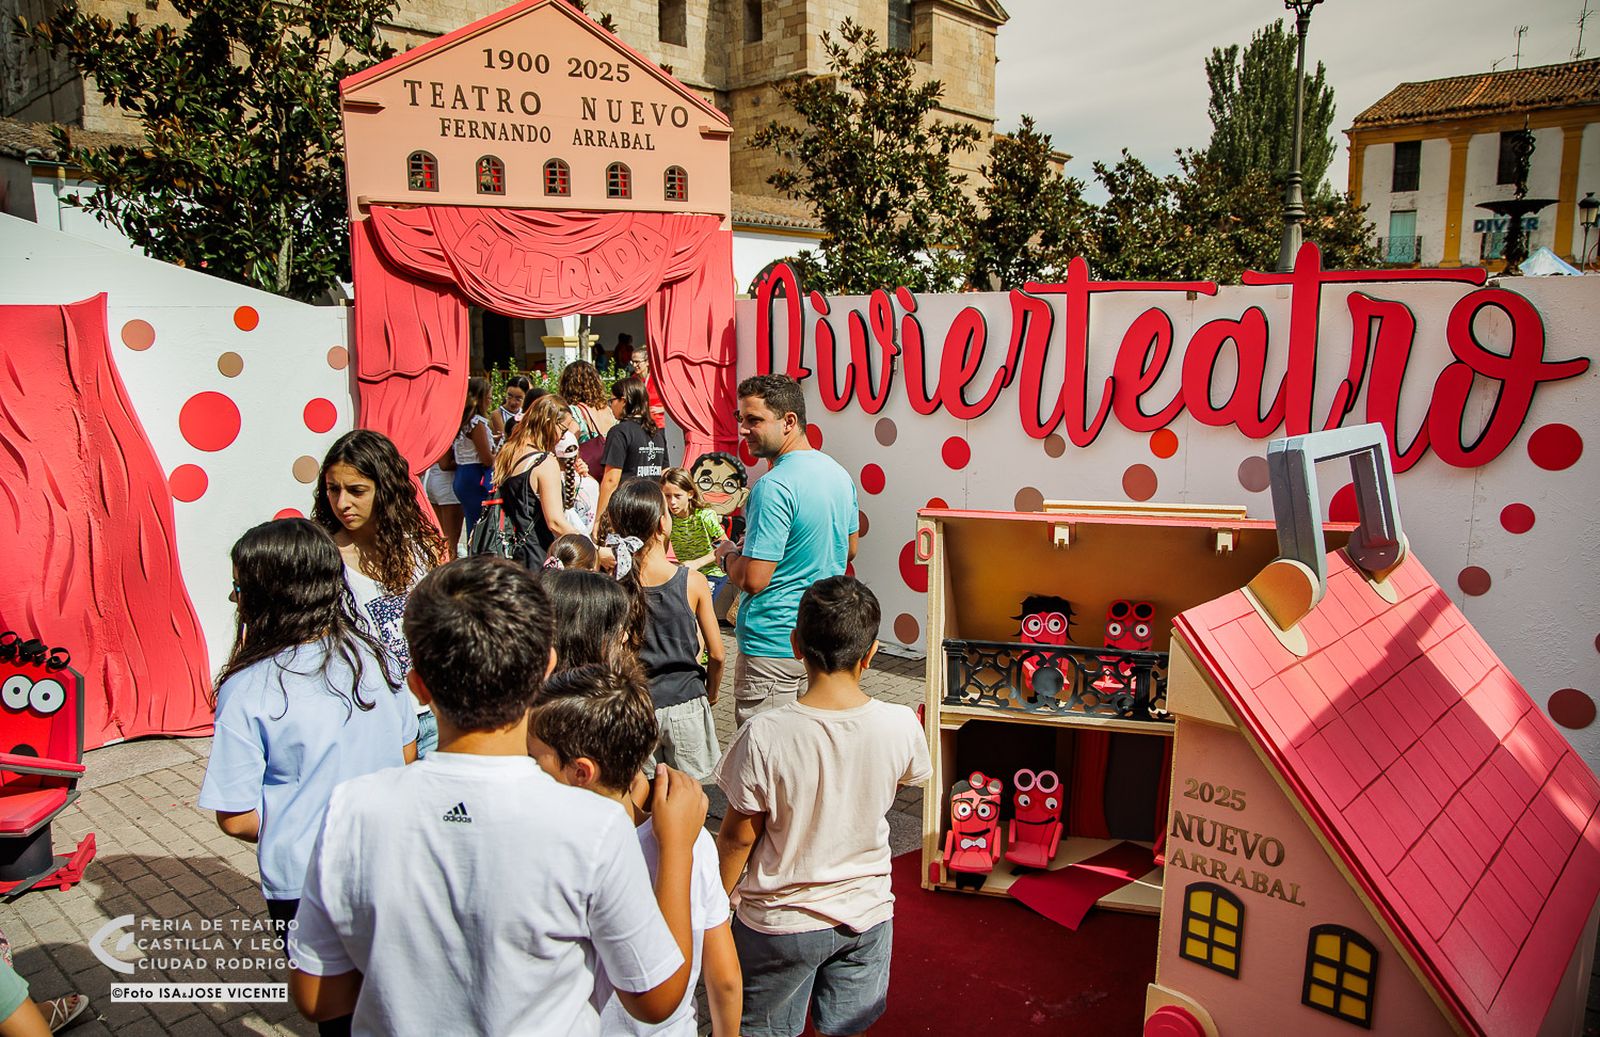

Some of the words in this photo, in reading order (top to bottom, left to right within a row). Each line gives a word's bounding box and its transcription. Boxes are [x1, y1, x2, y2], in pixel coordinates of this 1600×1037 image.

[483, 48, 550, 74] 1900
[567, 57, 631, 82] 2025
[403, 79, 542, 116] TEATRO
[581, 97, 689, 128] NUEVO
[440, 118, 551, 144] FERNANDO
[572, 128, 655, 151] ARRABAL
[1474, 217, 1539, 233] DIVR
[453, 219, 669, 299] ENTRADA
[1183, 777, 1247, 812] 2025
[443, 815, 472, 823] adidas
[1170, 810, 1285, 867] NUEVO
[1169, 847, 1306, 907] ARRABAL
